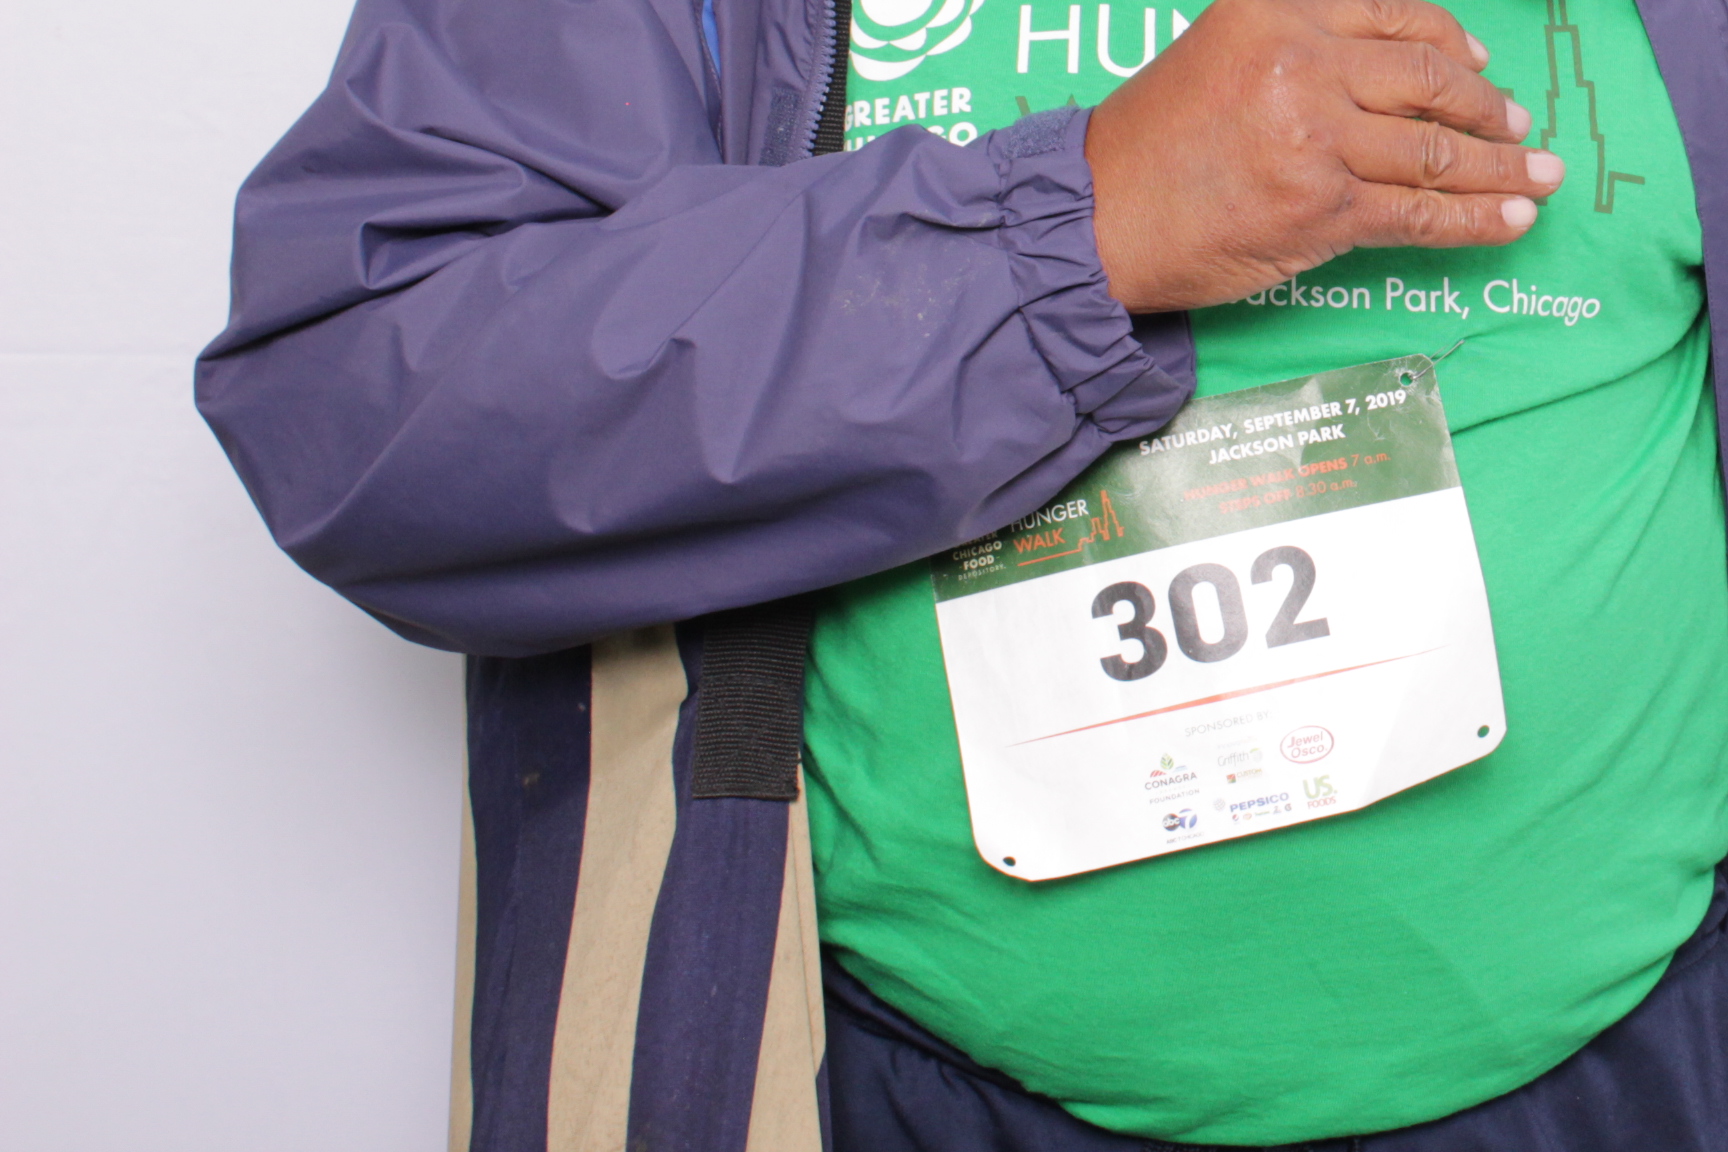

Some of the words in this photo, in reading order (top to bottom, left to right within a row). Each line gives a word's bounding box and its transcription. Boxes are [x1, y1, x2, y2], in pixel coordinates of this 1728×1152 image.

[1229, 276, 1371, 309] ackson
[1385, 277, 1471, 320] Park,
[1483, 278, 1600, 326] Chicago
[1139, 423, 1238, 456] SATURDAY,
[1244, 401, 1342, 434] SEPTEMBER
[1345, 398, 1360, 416] 7,
[1366, 389, 1407, 411] 2019
[1209, 434, 1294, 465] JACKSON
[1300, 424, 1346, 445] PARK
[1249, 468, 1296, 487] WALK
[1298, 457, 1348, 477] OPENS
[1351, 454, 1360, 466] 7
[1364, 452, 1391, 465] a.m.
[1263, 488, 1292, 505] OFF
[1011, 499, 1089, 533] HUNGER
[952, 540, 1002, 561] CHICAGO
[1013, 528, 1066, 554] WALK
[963, 554, 995, 570] FOOD
[1091, 545, 1331, 682] 302
[1184, 713, 1254, 737] SPONSORED
[1287, 731, 1324, 748] Jewel
[1144, 771, 1198, 791] CONAGRA
[1149, 788, 1200, 805] FOUNDATION
[1230, 792, 1290, 813] PEPSICO
[1307, 796, 1337, 809] FOODS
